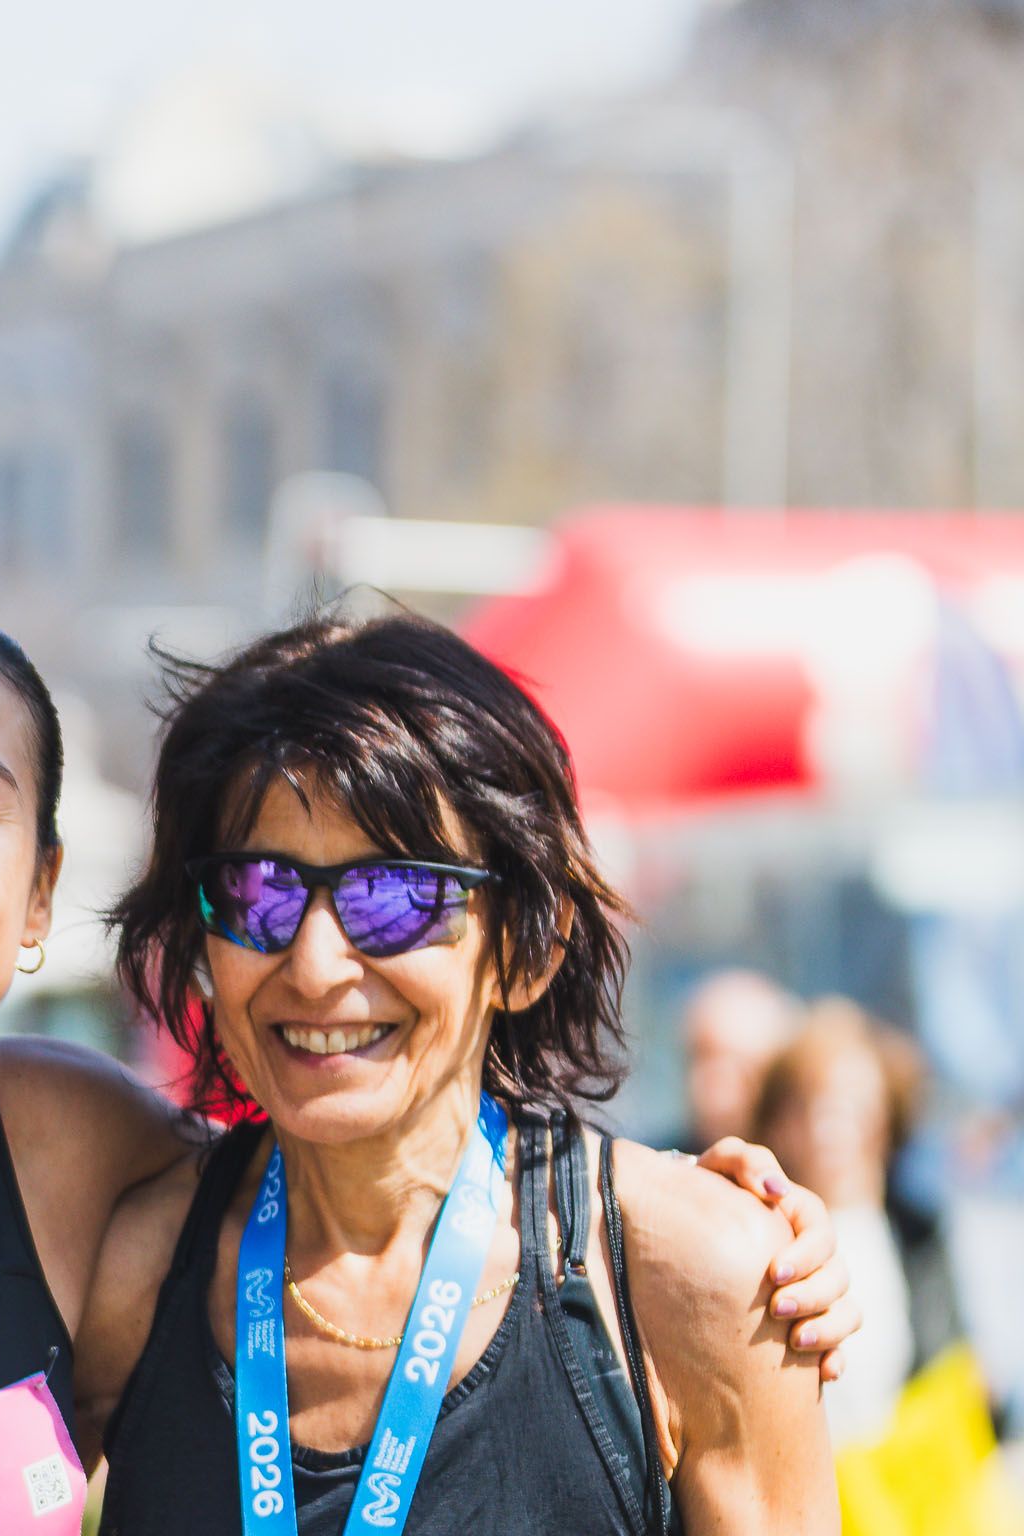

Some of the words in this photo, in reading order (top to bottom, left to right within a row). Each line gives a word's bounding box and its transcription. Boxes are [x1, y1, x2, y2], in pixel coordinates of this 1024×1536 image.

[257, 1143, 281, 1222] 026
[404, 1278, 463, 1386] 2026
[247, 1409, 284, 1519] 2026
